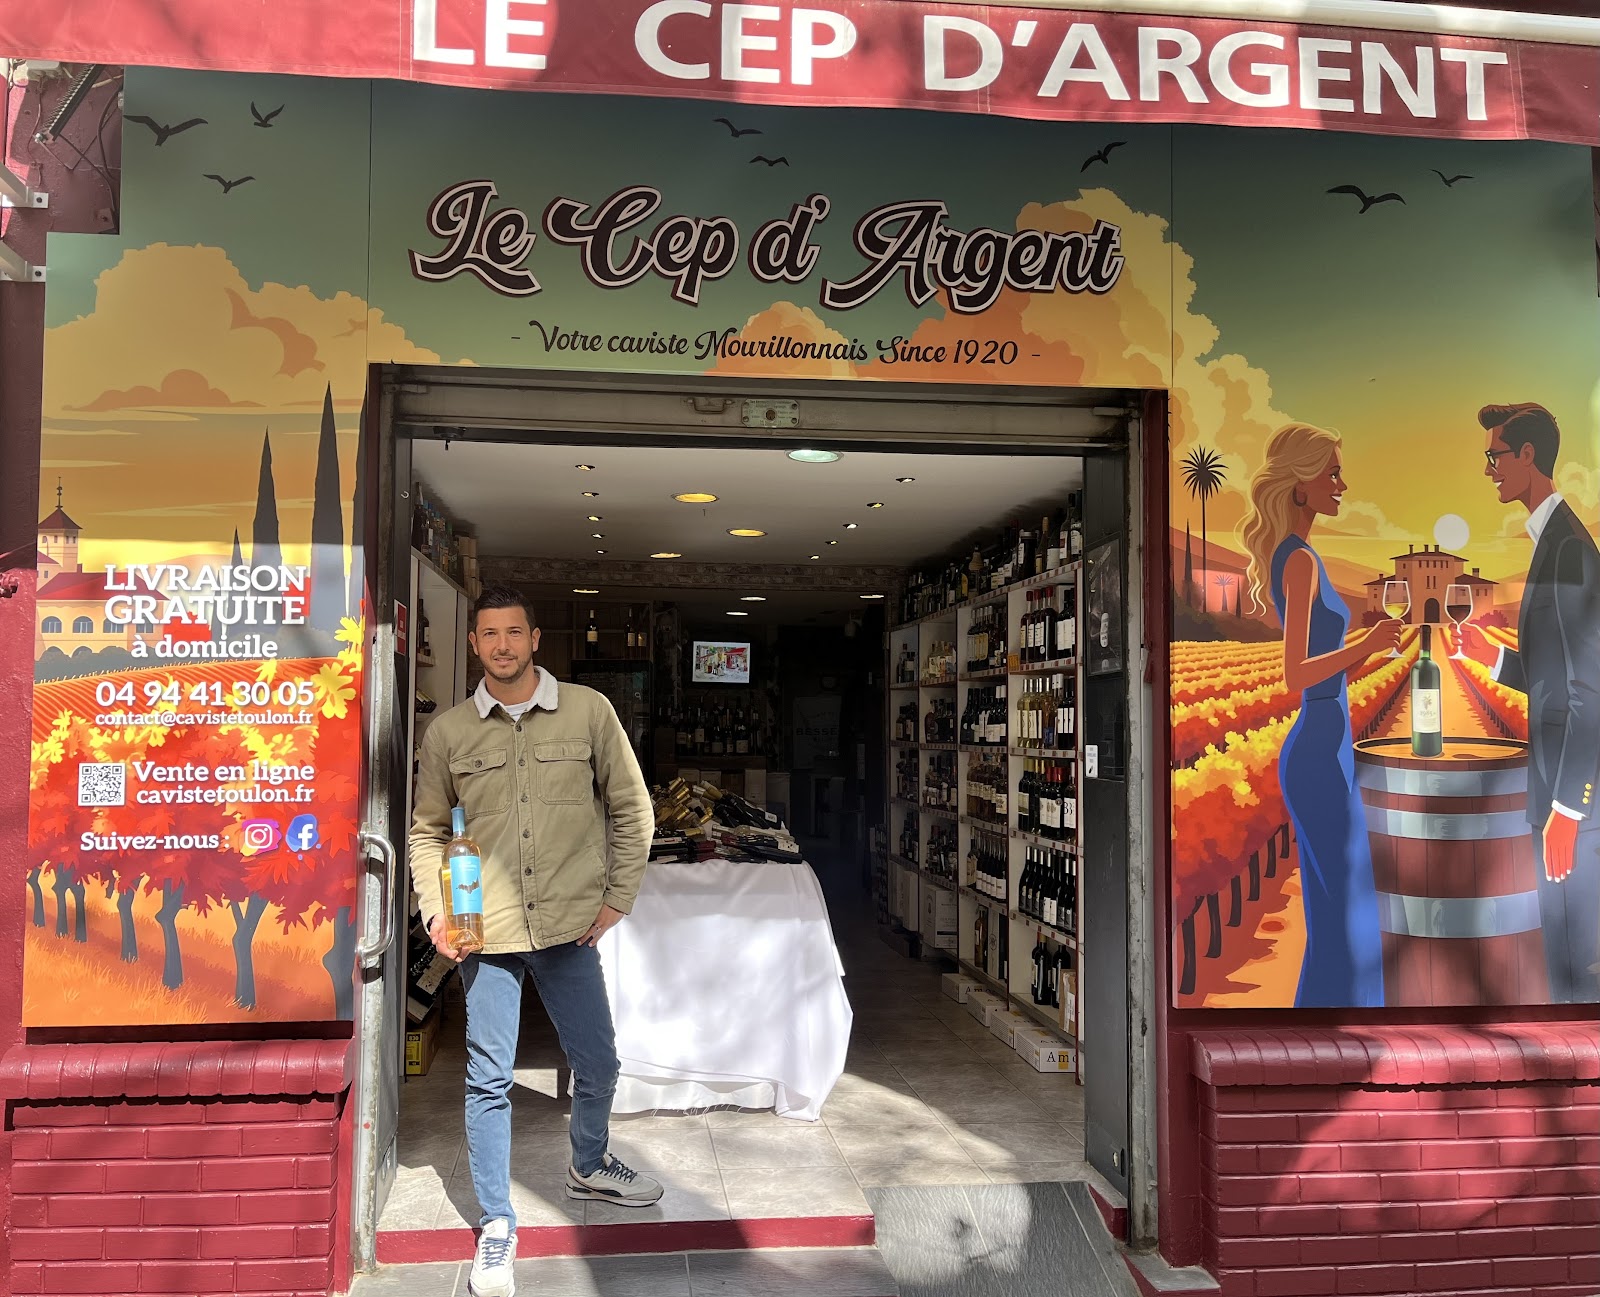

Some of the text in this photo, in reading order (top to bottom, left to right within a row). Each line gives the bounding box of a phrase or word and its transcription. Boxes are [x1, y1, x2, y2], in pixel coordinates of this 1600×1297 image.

[412, 0, 1508, 121] LE CEP D'ARGENT
[408, 180, 542, 297] Le
[542, 185, 739, 307] Cep
[528, 320, 604, 353] Votre
[607, 332, 689, 356] caviste
[694, 327, 868, 362] Mourillonnais
[876, 336, 947, 365] Since
[953, 338, 1019, 366] 1920
[103, 564, 307, 592] LIVRAISON
[104, 595, 305, 626] GRATUITE
[131, 634, 278, 658] à domicile
[95, 681, 315, 706] 04 94 41 30 05
[95, 709, 313, 726] contact@cavistetoulon.fr
[132, 761, 315, 785] Vente en ligne
[136, 785, 315, 804] cavistetoulon.fr
[80, 831, 219, 851] Suivez-nous
